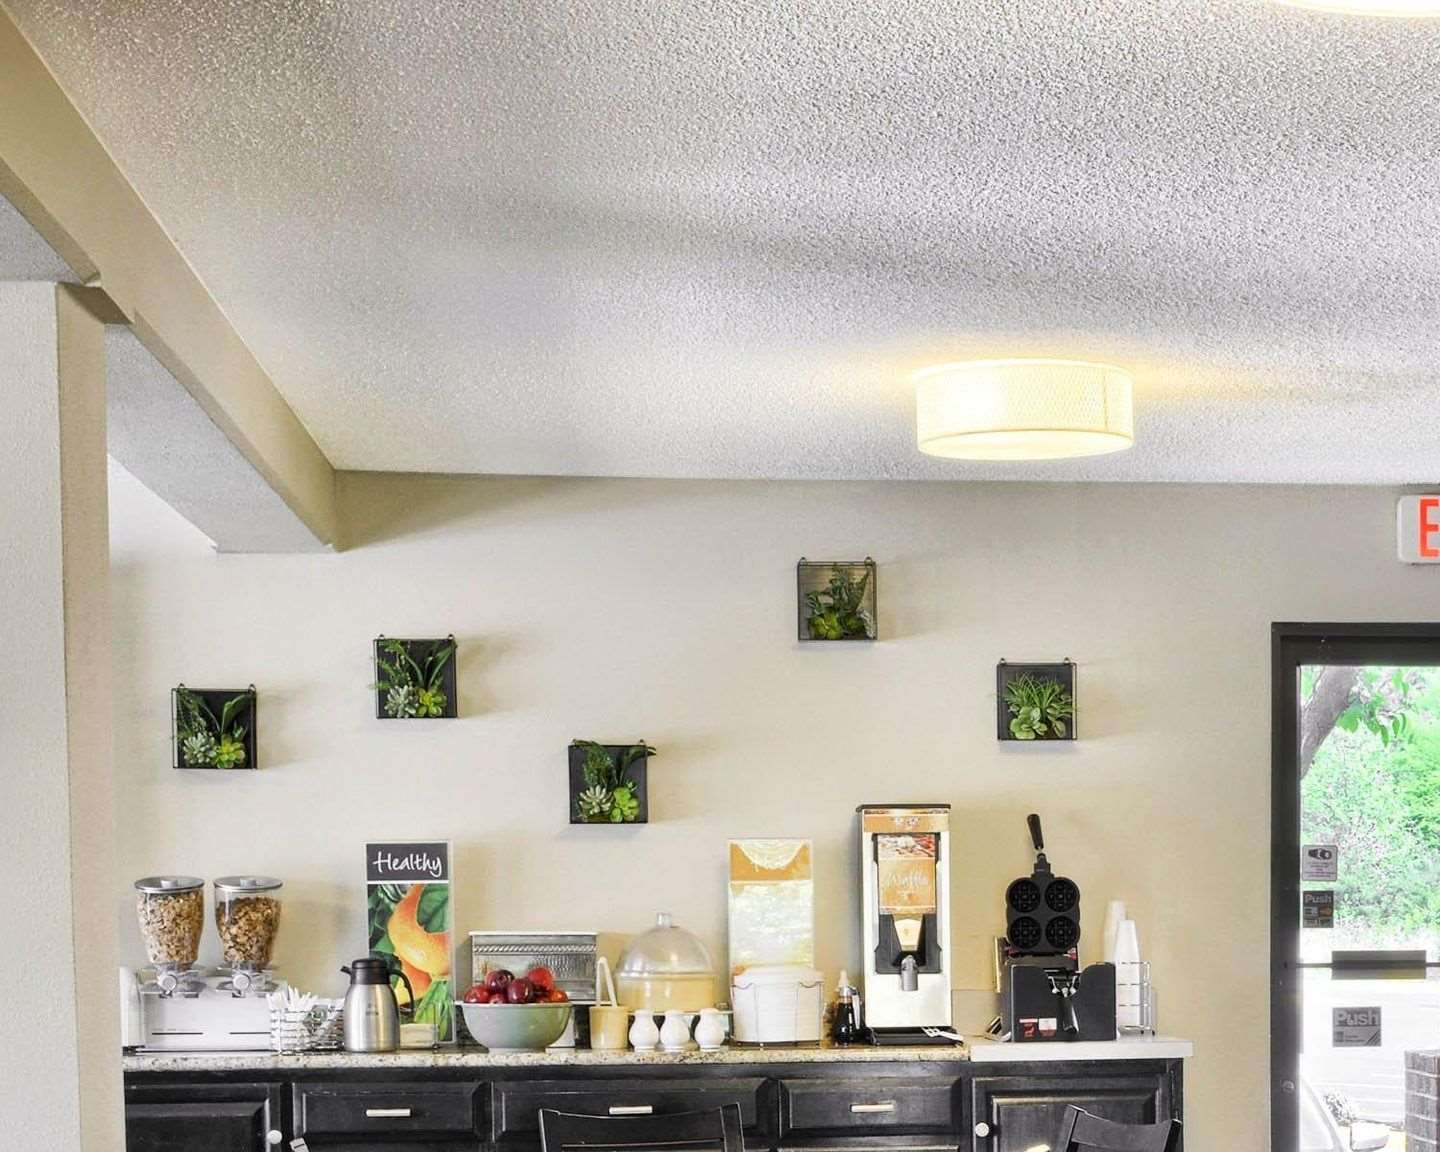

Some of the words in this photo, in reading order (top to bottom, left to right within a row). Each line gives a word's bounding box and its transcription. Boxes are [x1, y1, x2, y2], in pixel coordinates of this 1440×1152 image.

[372, 850, 443, 878] Healthy
[1304, 893, 1332, 904] Push
[1335, 1009, 1378, 1026] Push
